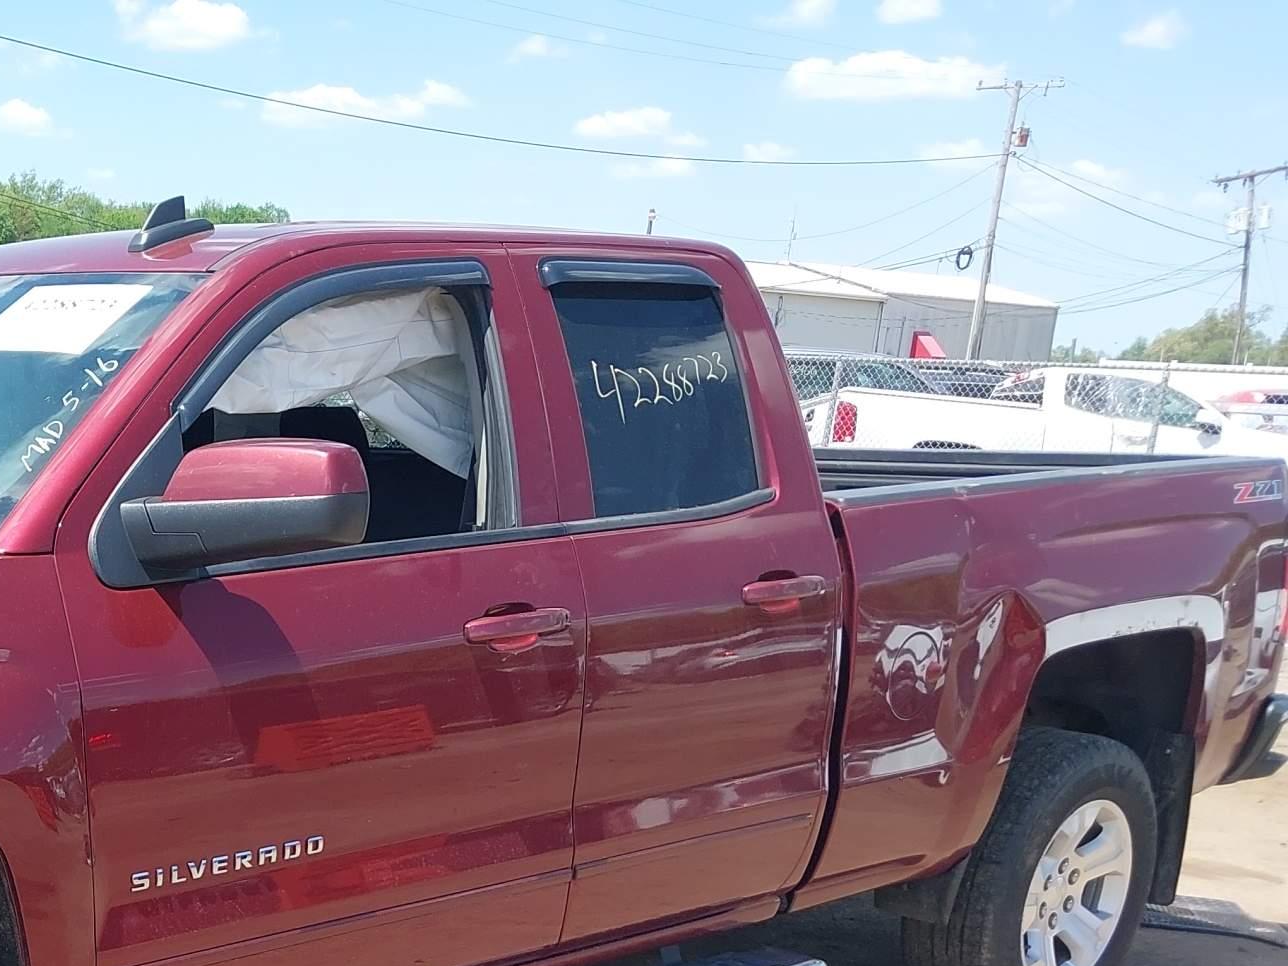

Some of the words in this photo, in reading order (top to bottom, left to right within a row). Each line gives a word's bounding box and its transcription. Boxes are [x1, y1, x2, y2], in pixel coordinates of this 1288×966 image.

[591, 351, 728, 425] 42288723
[21, 420, 64, 472] MAD
[1233, 479, 1282, 504] Z71
[130, 835, 325, 892] SILVERADO
